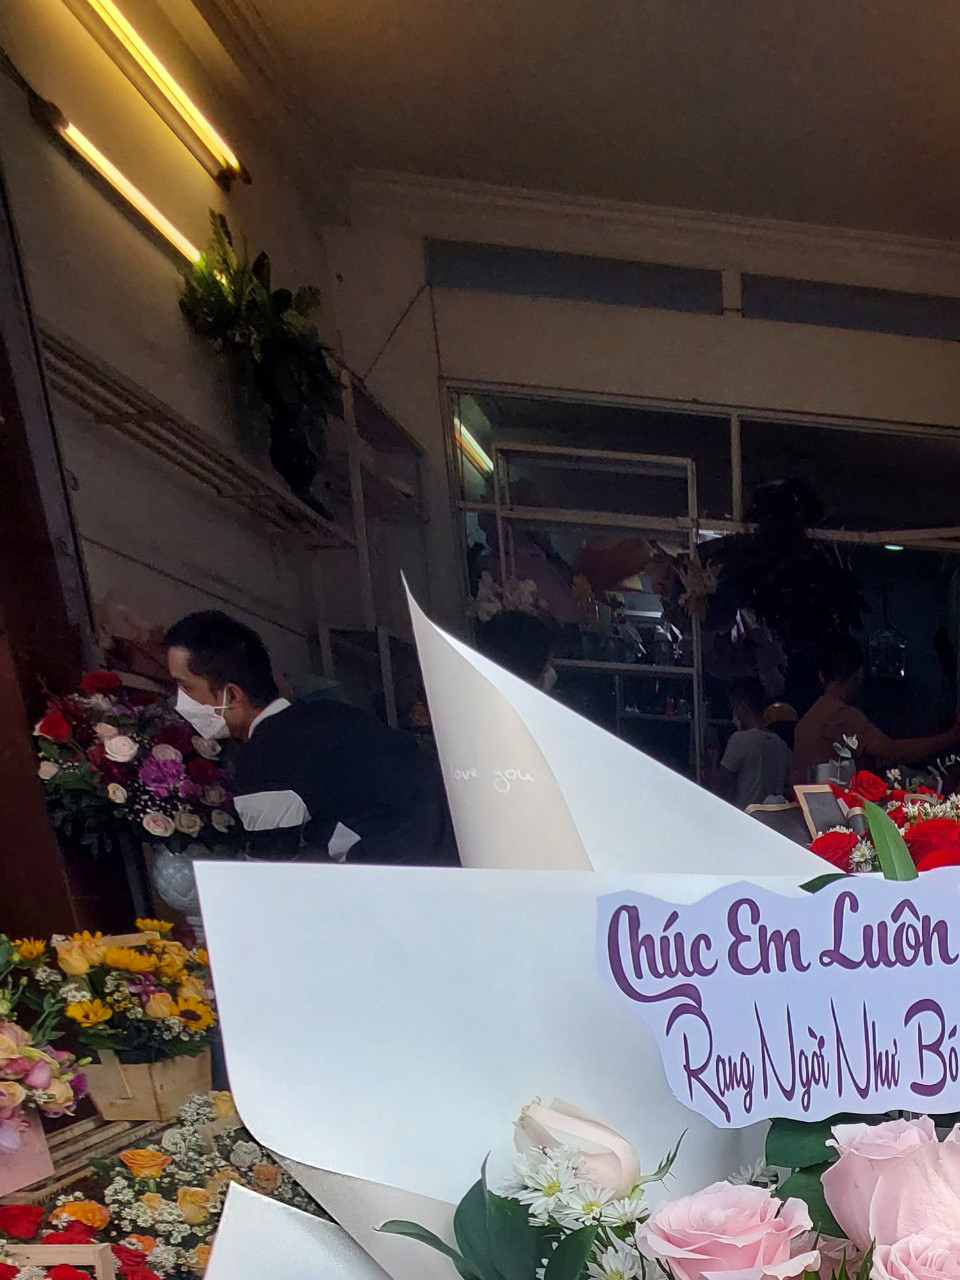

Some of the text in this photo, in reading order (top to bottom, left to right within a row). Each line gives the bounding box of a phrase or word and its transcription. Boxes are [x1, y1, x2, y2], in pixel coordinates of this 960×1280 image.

[492, 767, 535, 794] you
[607, 904, 718, 1004] Chúc
[727, 897, 811, 976] Em
[818, 891, 960, 970] Luôn
[666, 1002, 754, 1123] Rang
[830, 997, 900, 1100] Như
[904, 998, 959, 1097] Bó
